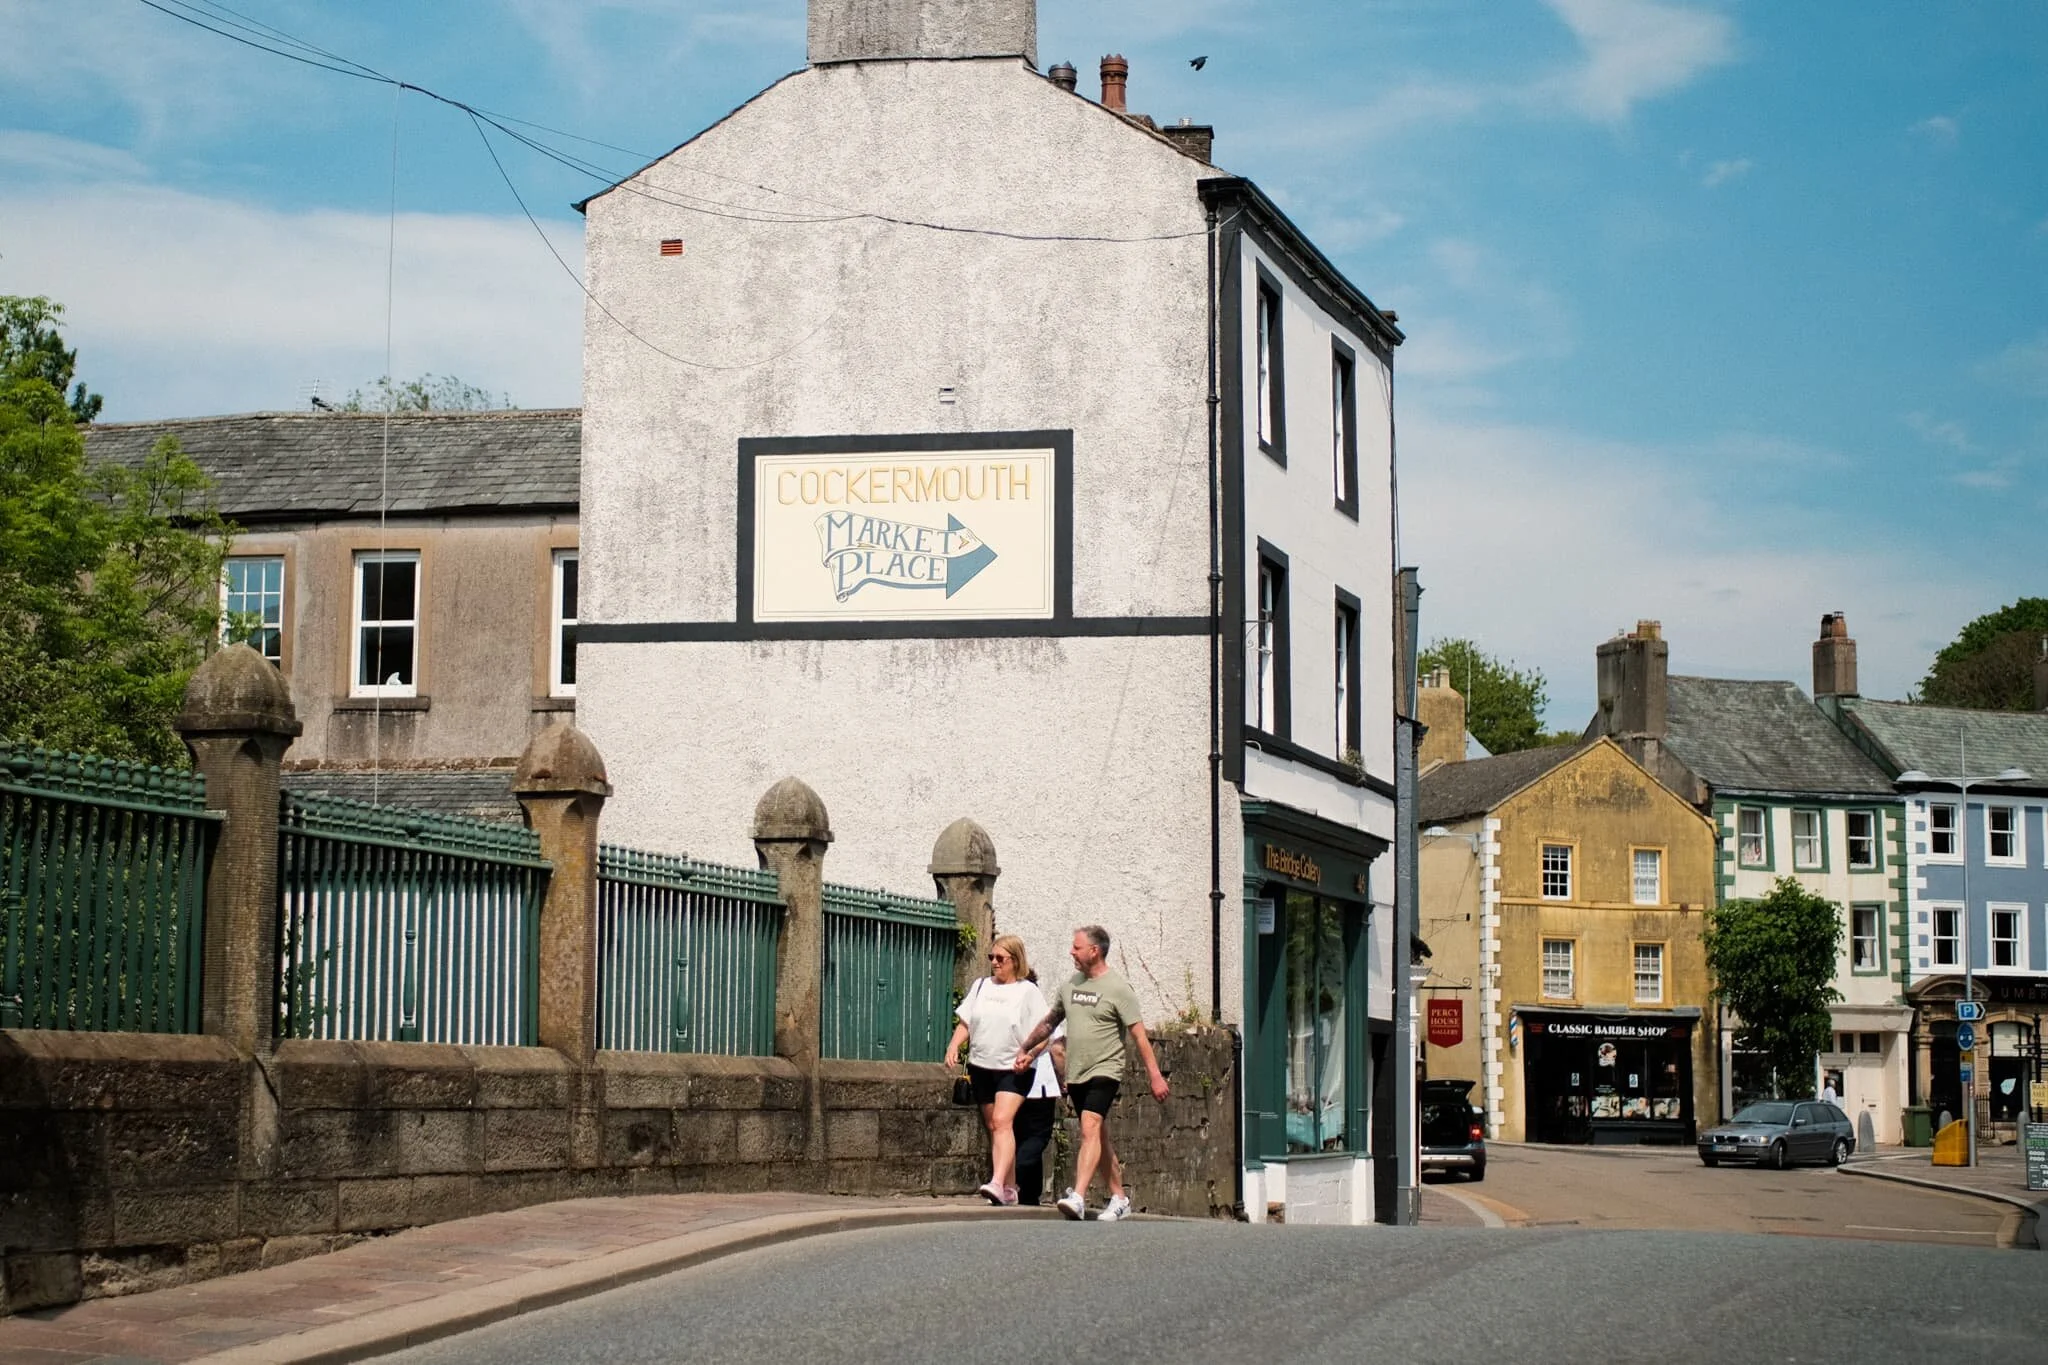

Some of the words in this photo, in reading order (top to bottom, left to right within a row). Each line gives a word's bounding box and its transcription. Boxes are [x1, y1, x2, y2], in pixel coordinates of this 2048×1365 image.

[777, 463, 1031, 505] COCKERMOUTH
[1266, 844, 1279, 870] The
[1280, 848, 1300, 880] Bridge
[1300, 853, 1320, 888] Gallery
[1431, 1008, 1459, 1017] PERCY
[1963, 1005, 1972, 1017] P
[1431, 1017, 1459, 1025] HOUSE
[1548, 1023, 1593, 1034] CLASSIC
[1594, 1024, 1636, 1036] BARBER
[1637, 1026, 1668, 1037] SHOP
